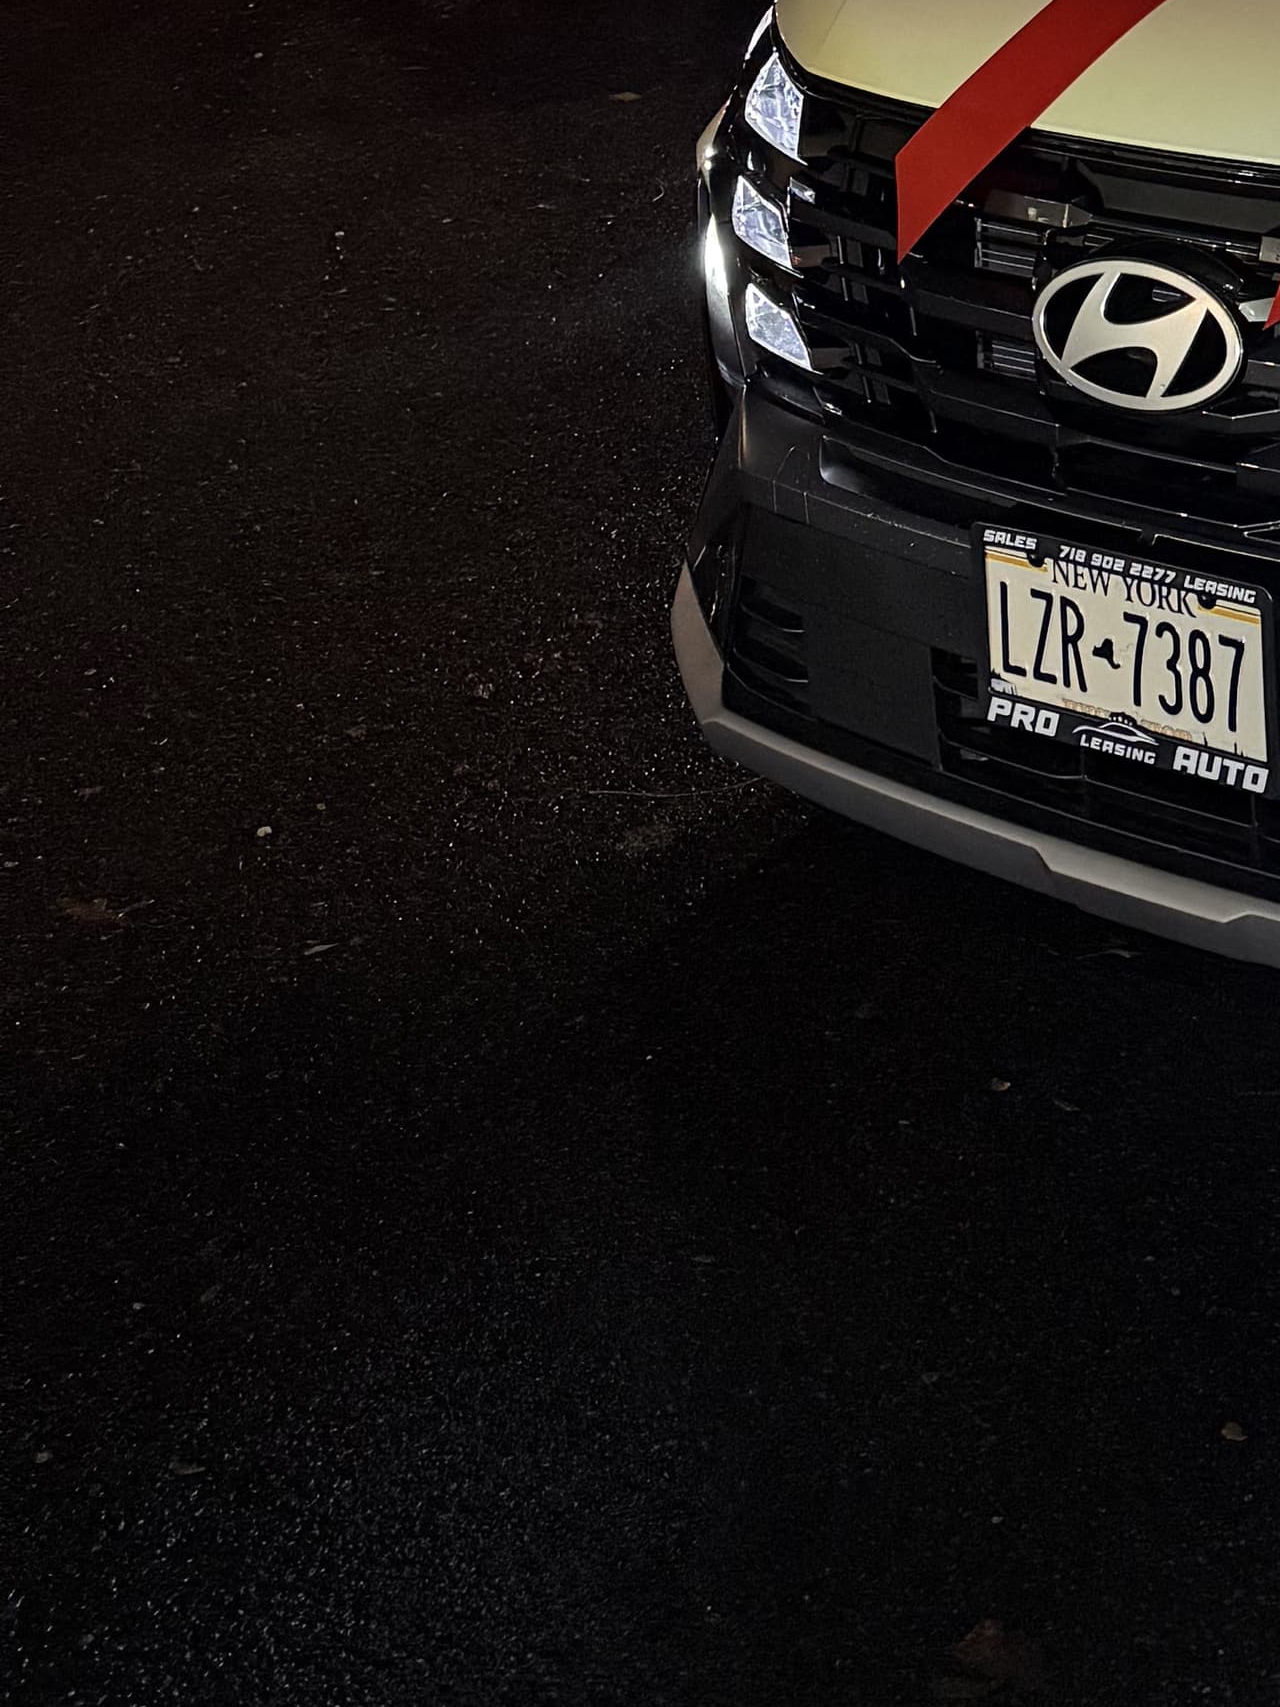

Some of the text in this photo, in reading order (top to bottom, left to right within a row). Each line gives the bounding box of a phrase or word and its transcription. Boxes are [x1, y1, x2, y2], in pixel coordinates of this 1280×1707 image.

[982, 528, 1257, 604] SALES 718 902 2277 LEASING
[1049, 557, 1198, 618] NEW YORK
[1000, 581, 1246, 734] LZR 7387
[987, 697, 1060, 738] PRO
[1080, 733, 1156, 766] LEASING
[1173, 746, 1269, 794] AUTO
